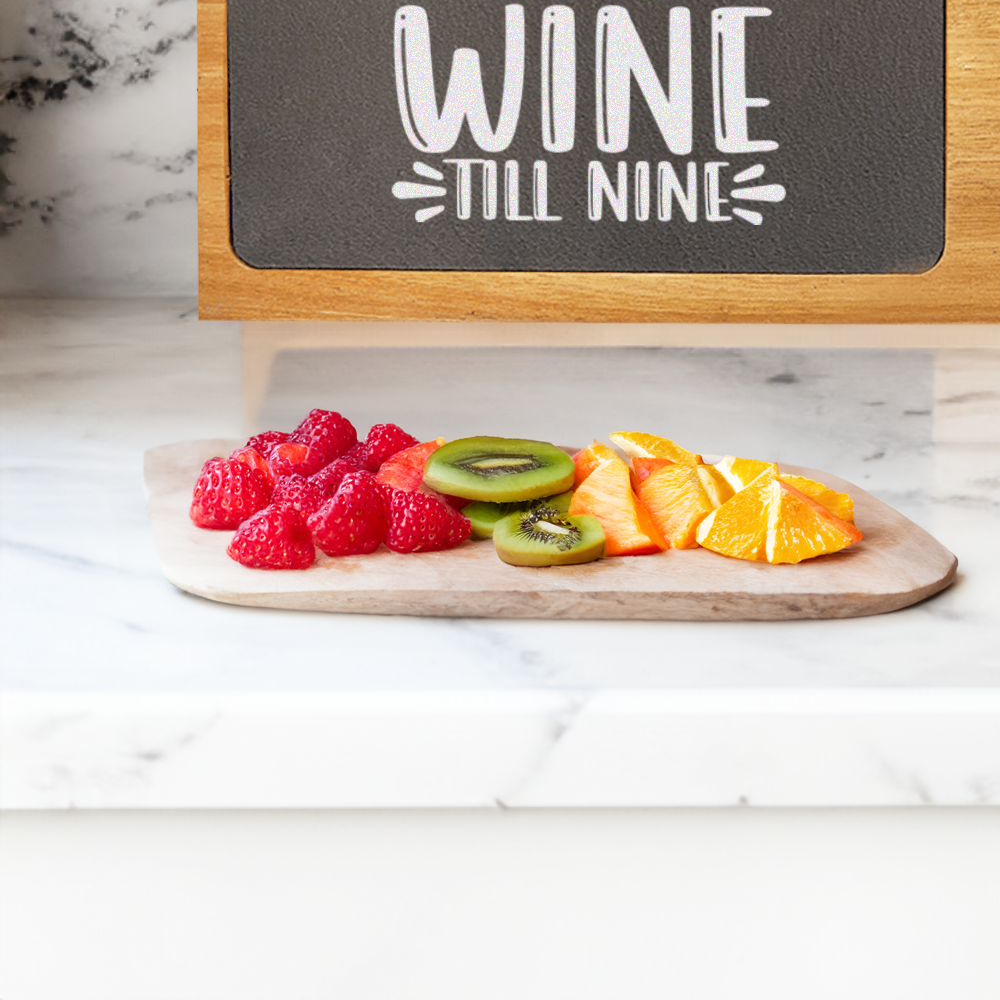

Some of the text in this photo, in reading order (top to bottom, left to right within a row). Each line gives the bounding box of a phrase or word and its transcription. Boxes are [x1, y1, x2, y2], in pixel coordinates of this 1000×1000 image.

[394, 3, 779, 154] WINE
[442, 159, 733, 223] TILL NINE
